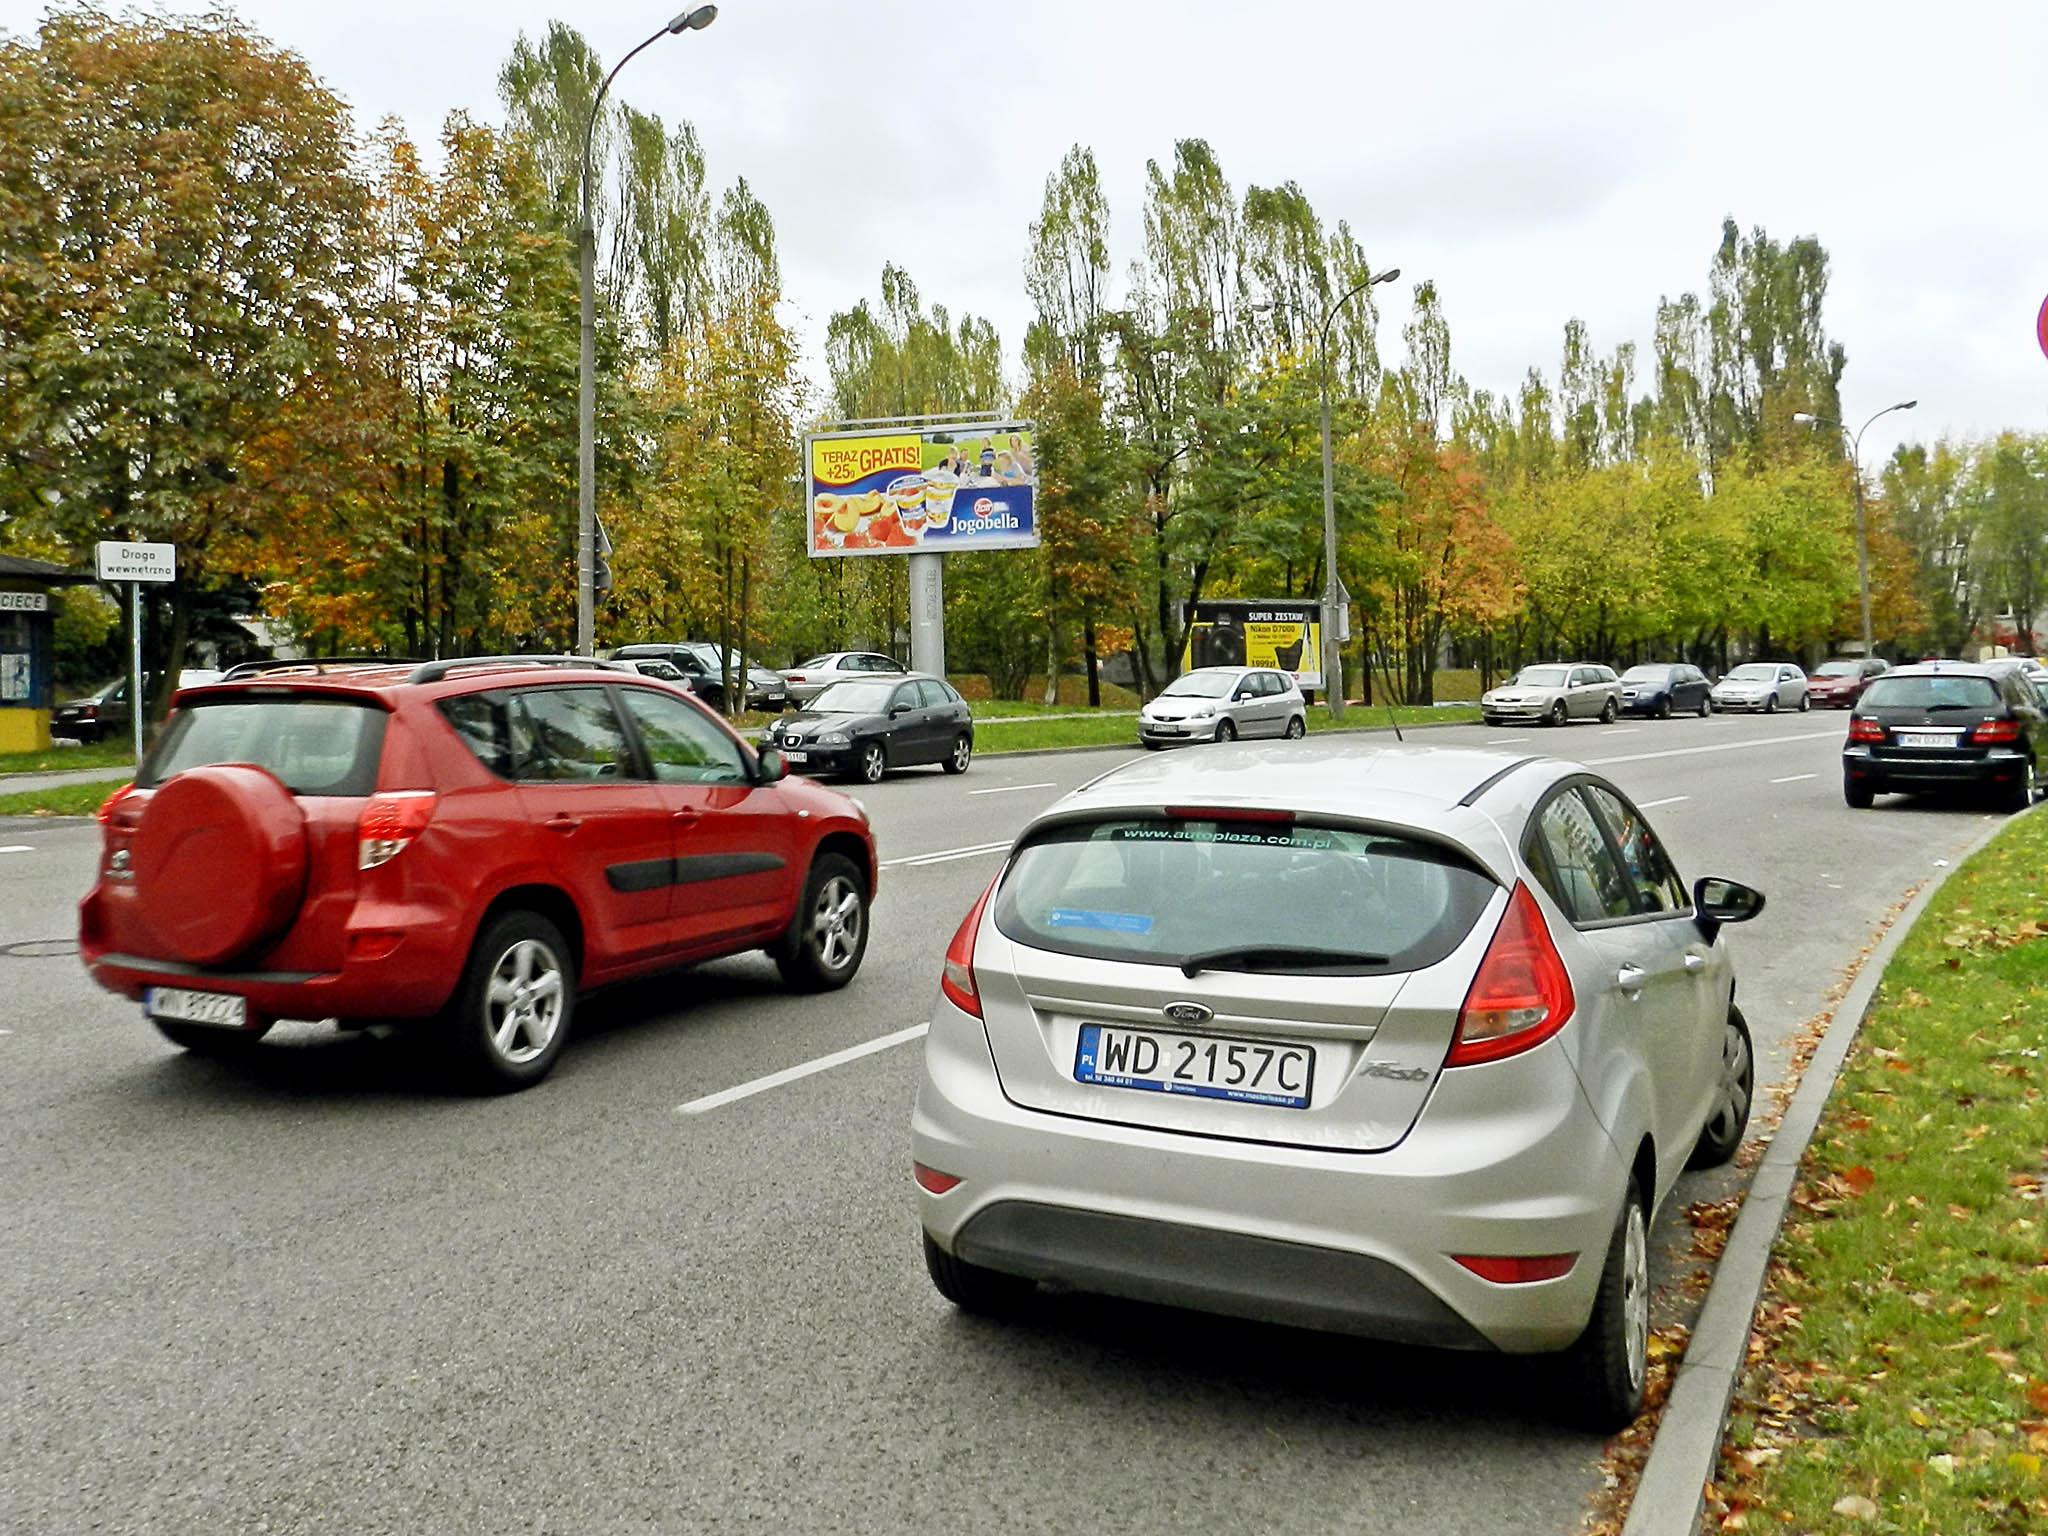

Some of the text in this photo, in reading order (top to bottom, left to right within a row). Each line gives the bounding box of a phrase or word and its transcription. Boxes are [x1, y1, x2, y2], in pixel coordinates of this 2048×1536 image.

[822, 447, 920, 473] TERAZ GRATIS!
[951, 514, 1019, 535] Jogobella
[121, 548, 156, 562] Droga
[1248, 612, 1304, 621] SUPER ZESTAW
[1123, 828, 1331, 849] www.autoplaza.com.pl
[1173, 1007, 1201, 1020] Ford
[1081, 1055, 1095, 1066] PL
[1104, 1033, 1303, 1092] WD 2157C
